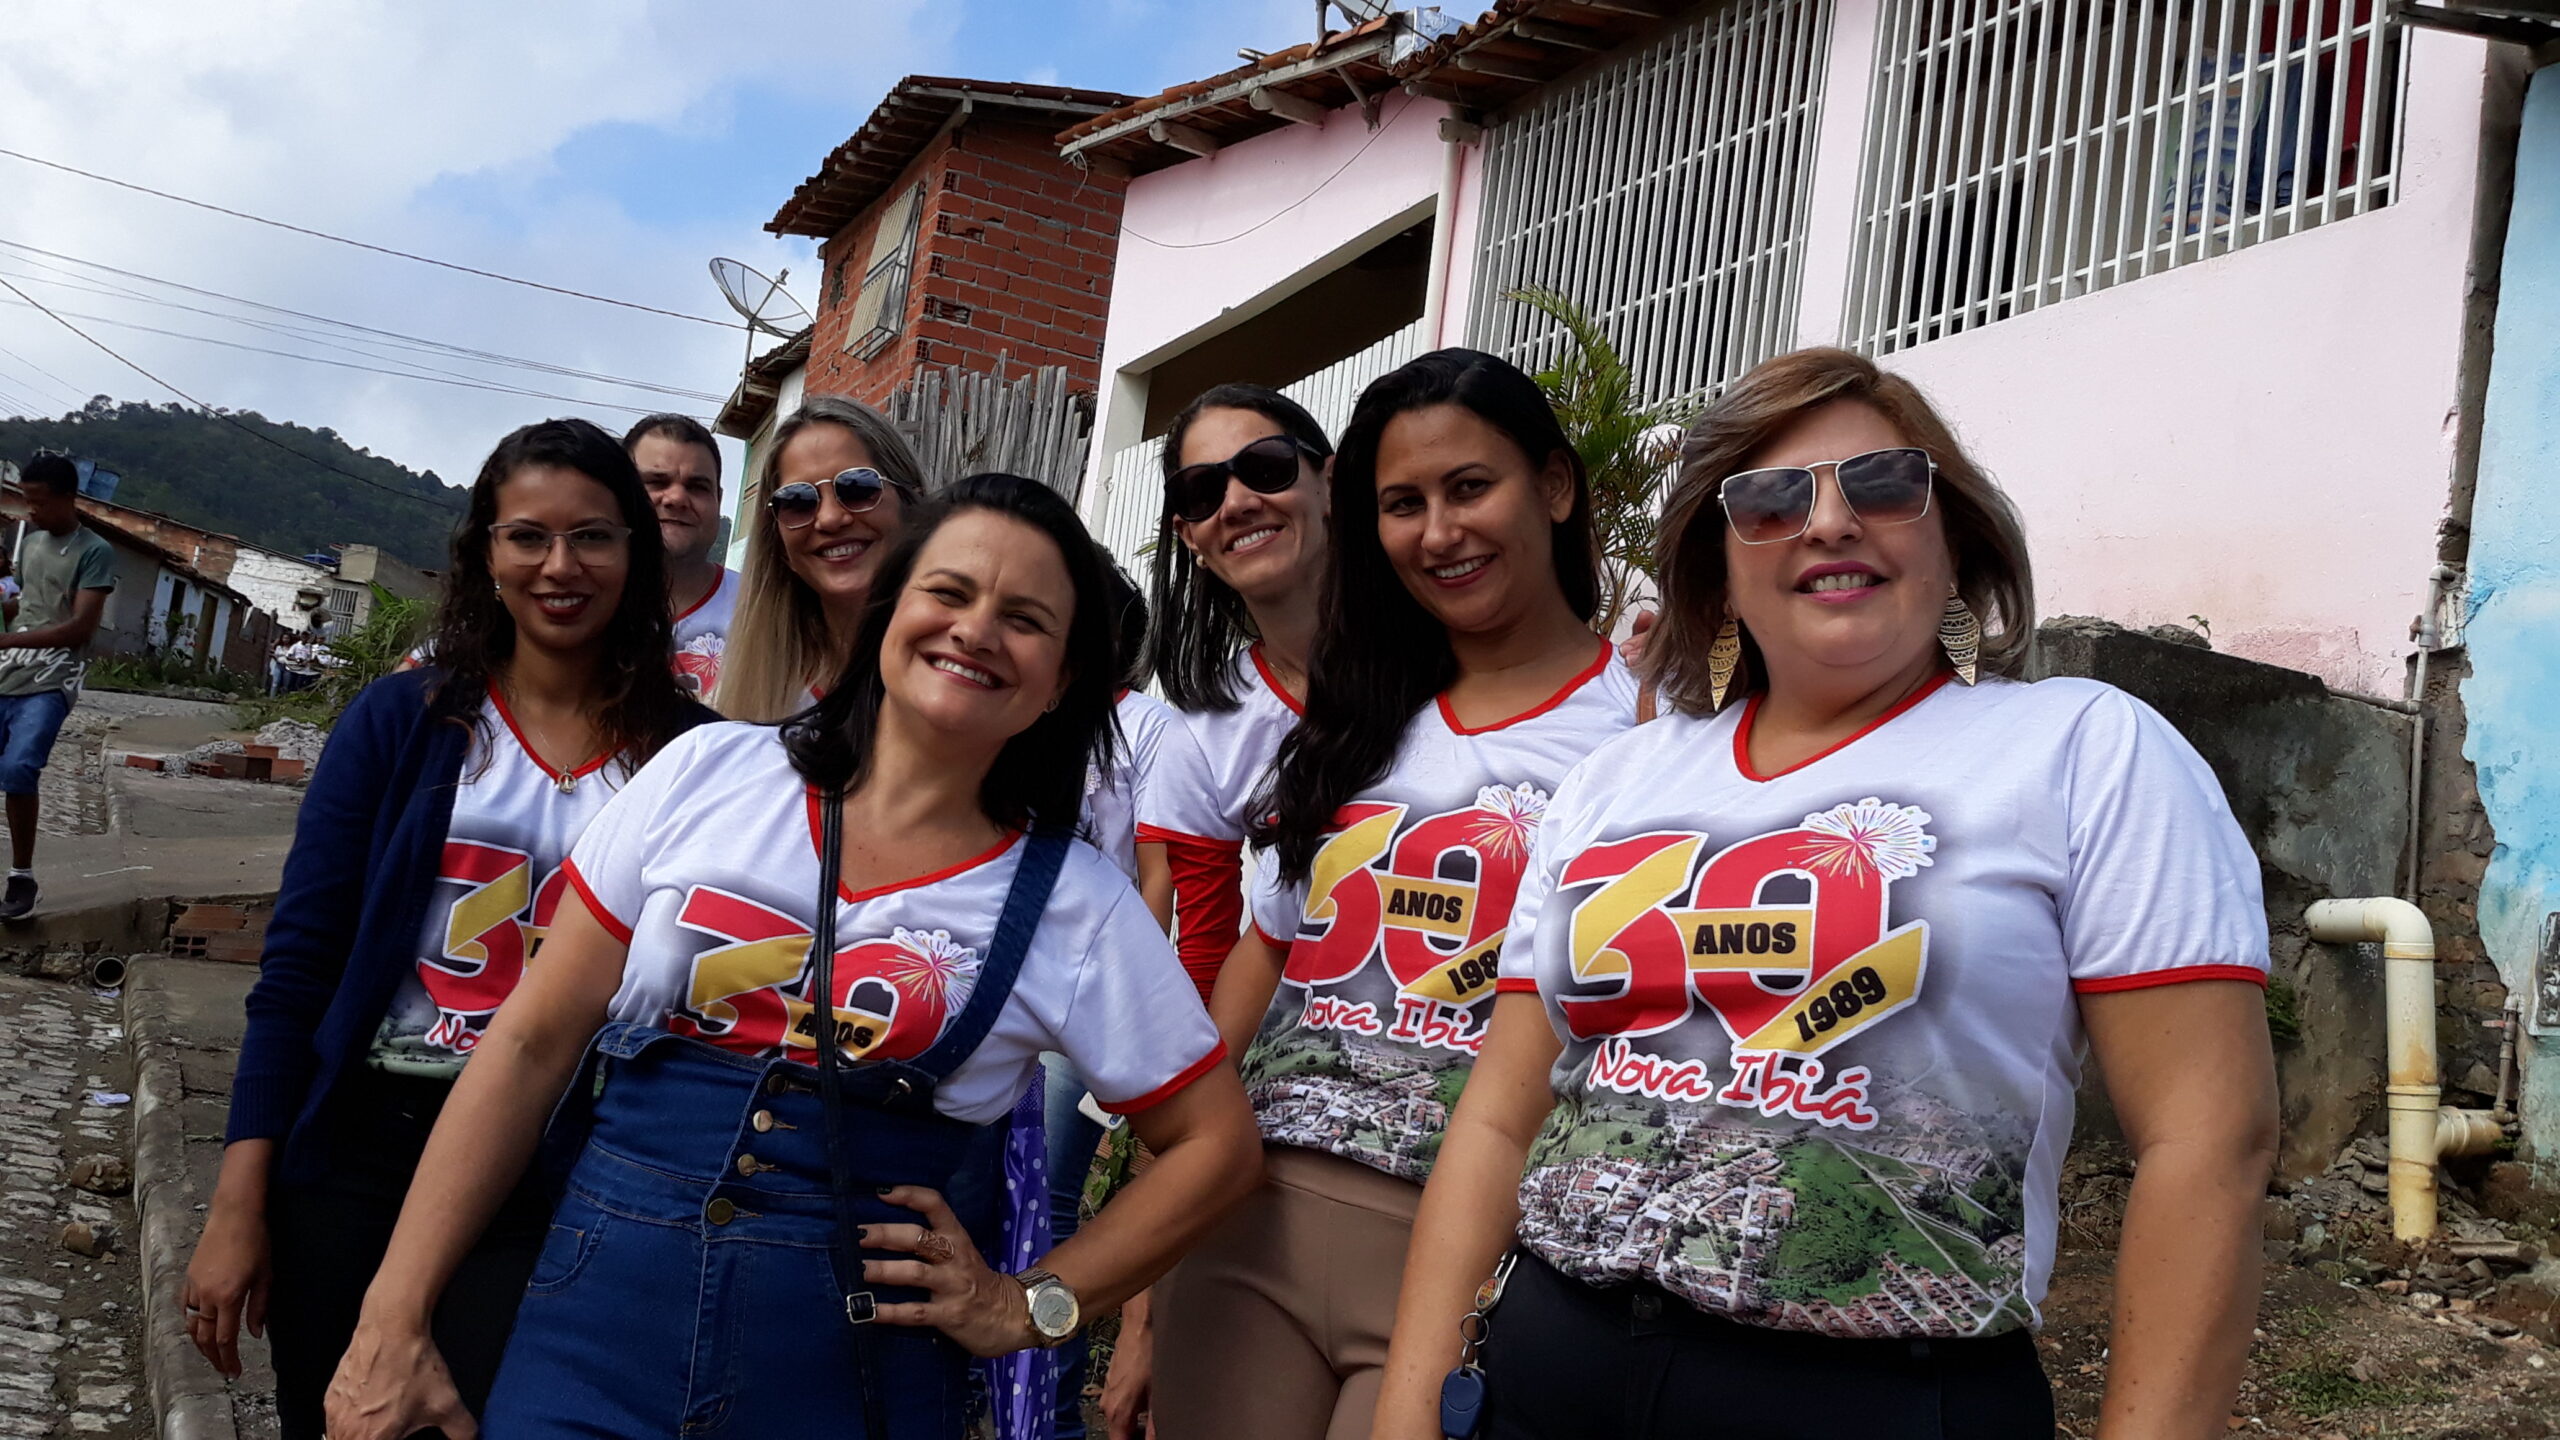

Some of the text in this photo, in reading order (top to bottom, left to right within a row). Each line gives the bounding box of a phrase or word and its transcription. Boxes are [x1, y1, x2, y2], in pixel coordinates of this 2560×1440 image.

[1388, 888, 1464, 924] ANOS
[1556, 829, 1892, 1054] 30
[1693, 921, 1797, 956] ANOS
[1446, 942, 1504, 997] 198
[1794, 966, 1887, 1043] 1989
[428, 1017, 484, 1052] No
[794, 1012, 874, 1049] AOS
[1588, 1042, 1875, 1125] Nova Ibiá
